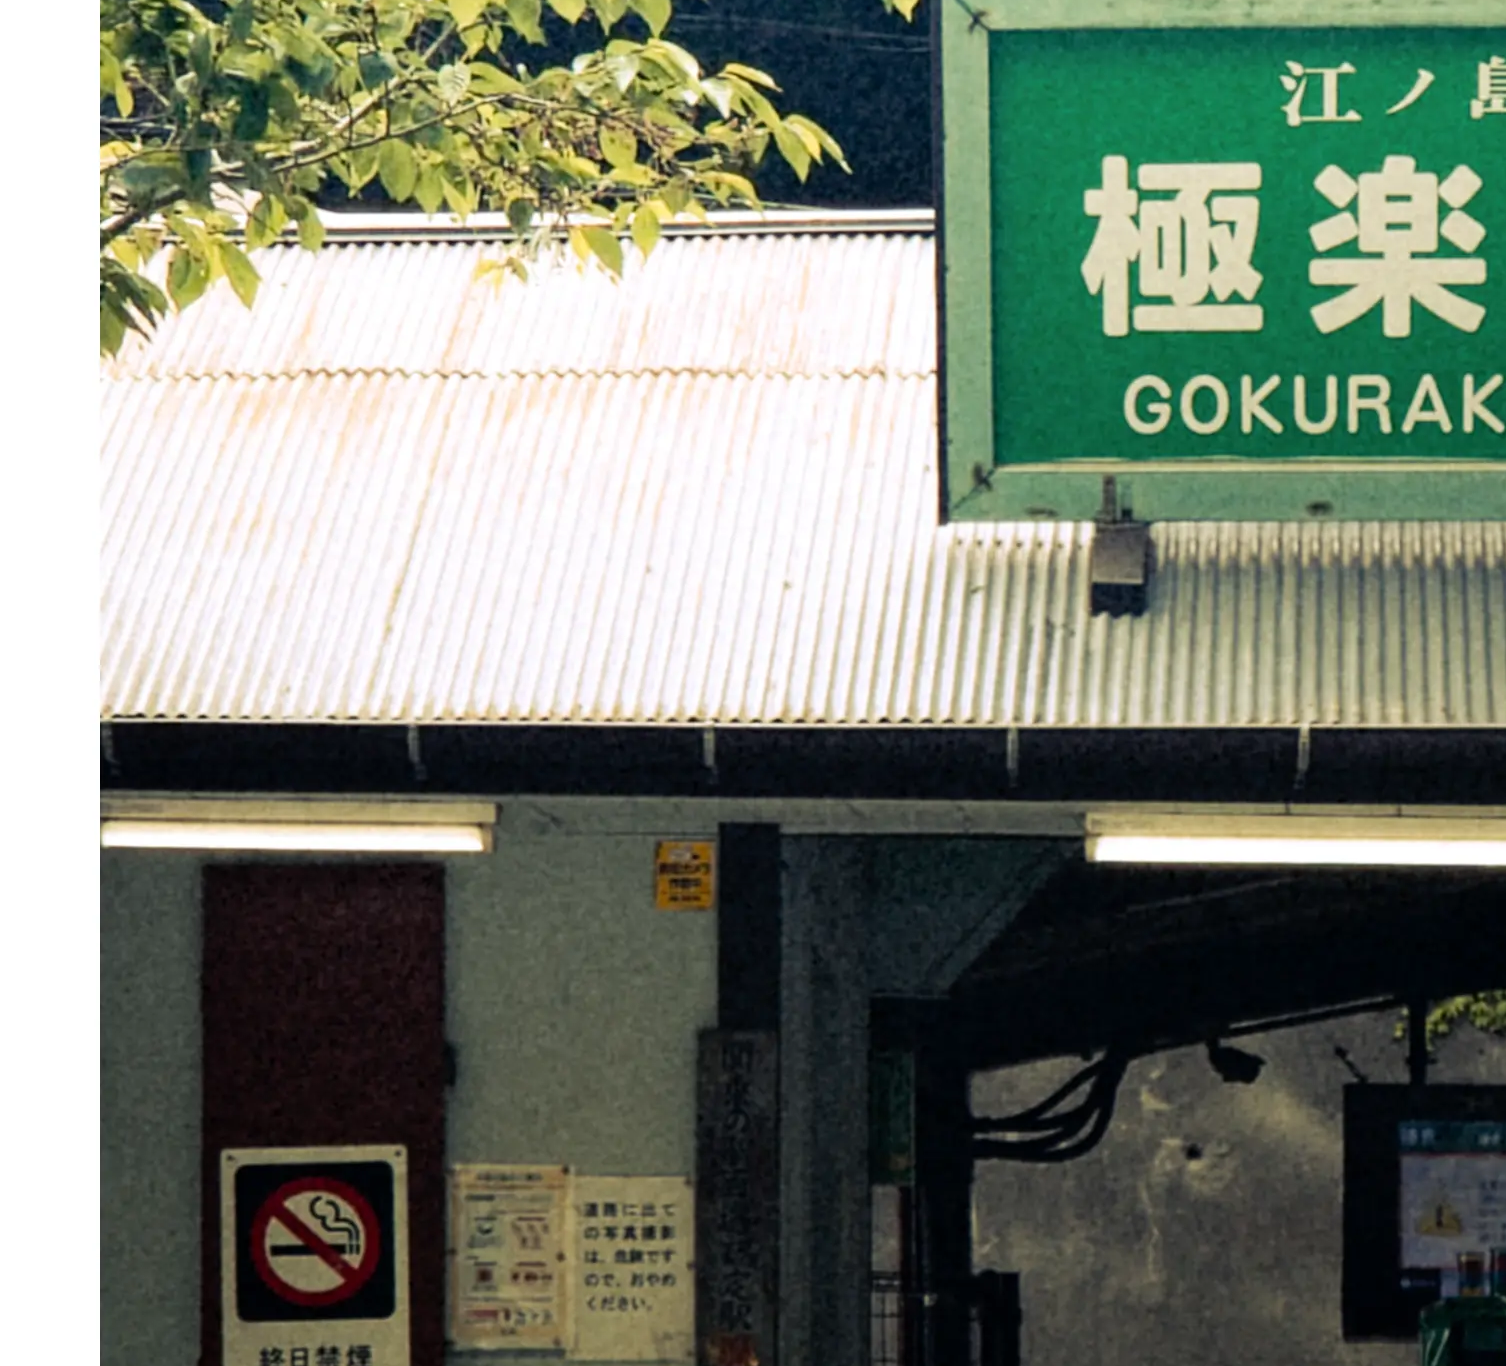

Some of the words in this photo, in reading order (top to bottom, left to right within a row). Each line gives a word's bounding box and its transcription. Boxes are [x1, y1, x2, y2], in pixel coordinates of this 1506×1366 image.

[583, 1202, 677, 1218] 道路に出て
[583, 1225, 677, 1241] の写真撮影
[586, 1295, 654, 1312] ください。
